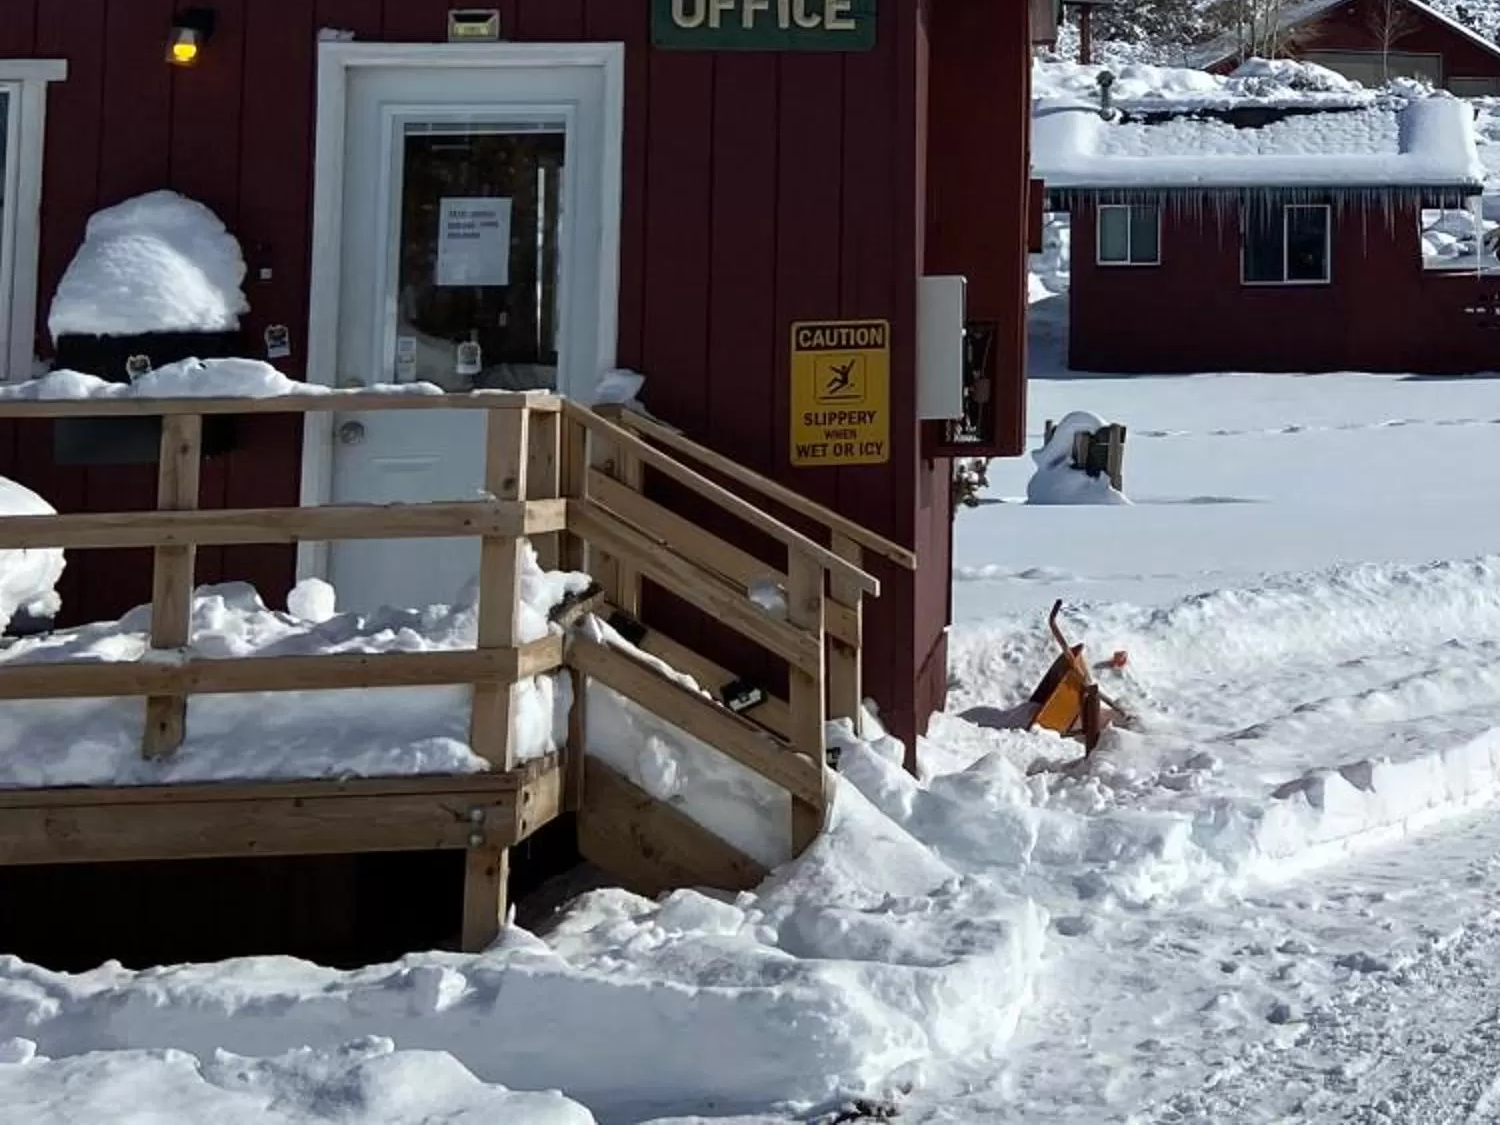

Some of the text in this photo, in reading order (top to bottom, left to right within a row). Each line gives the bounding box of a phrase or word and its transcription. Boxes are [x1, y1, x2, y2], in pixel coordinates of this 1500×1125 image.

[799, 327, 882, 347] CAUTION
[803, 410, 877, 426] SLIPPERY
[824, 428, 857, 440] WHEN
[796, 441, 883, 458] WET OR ICY
